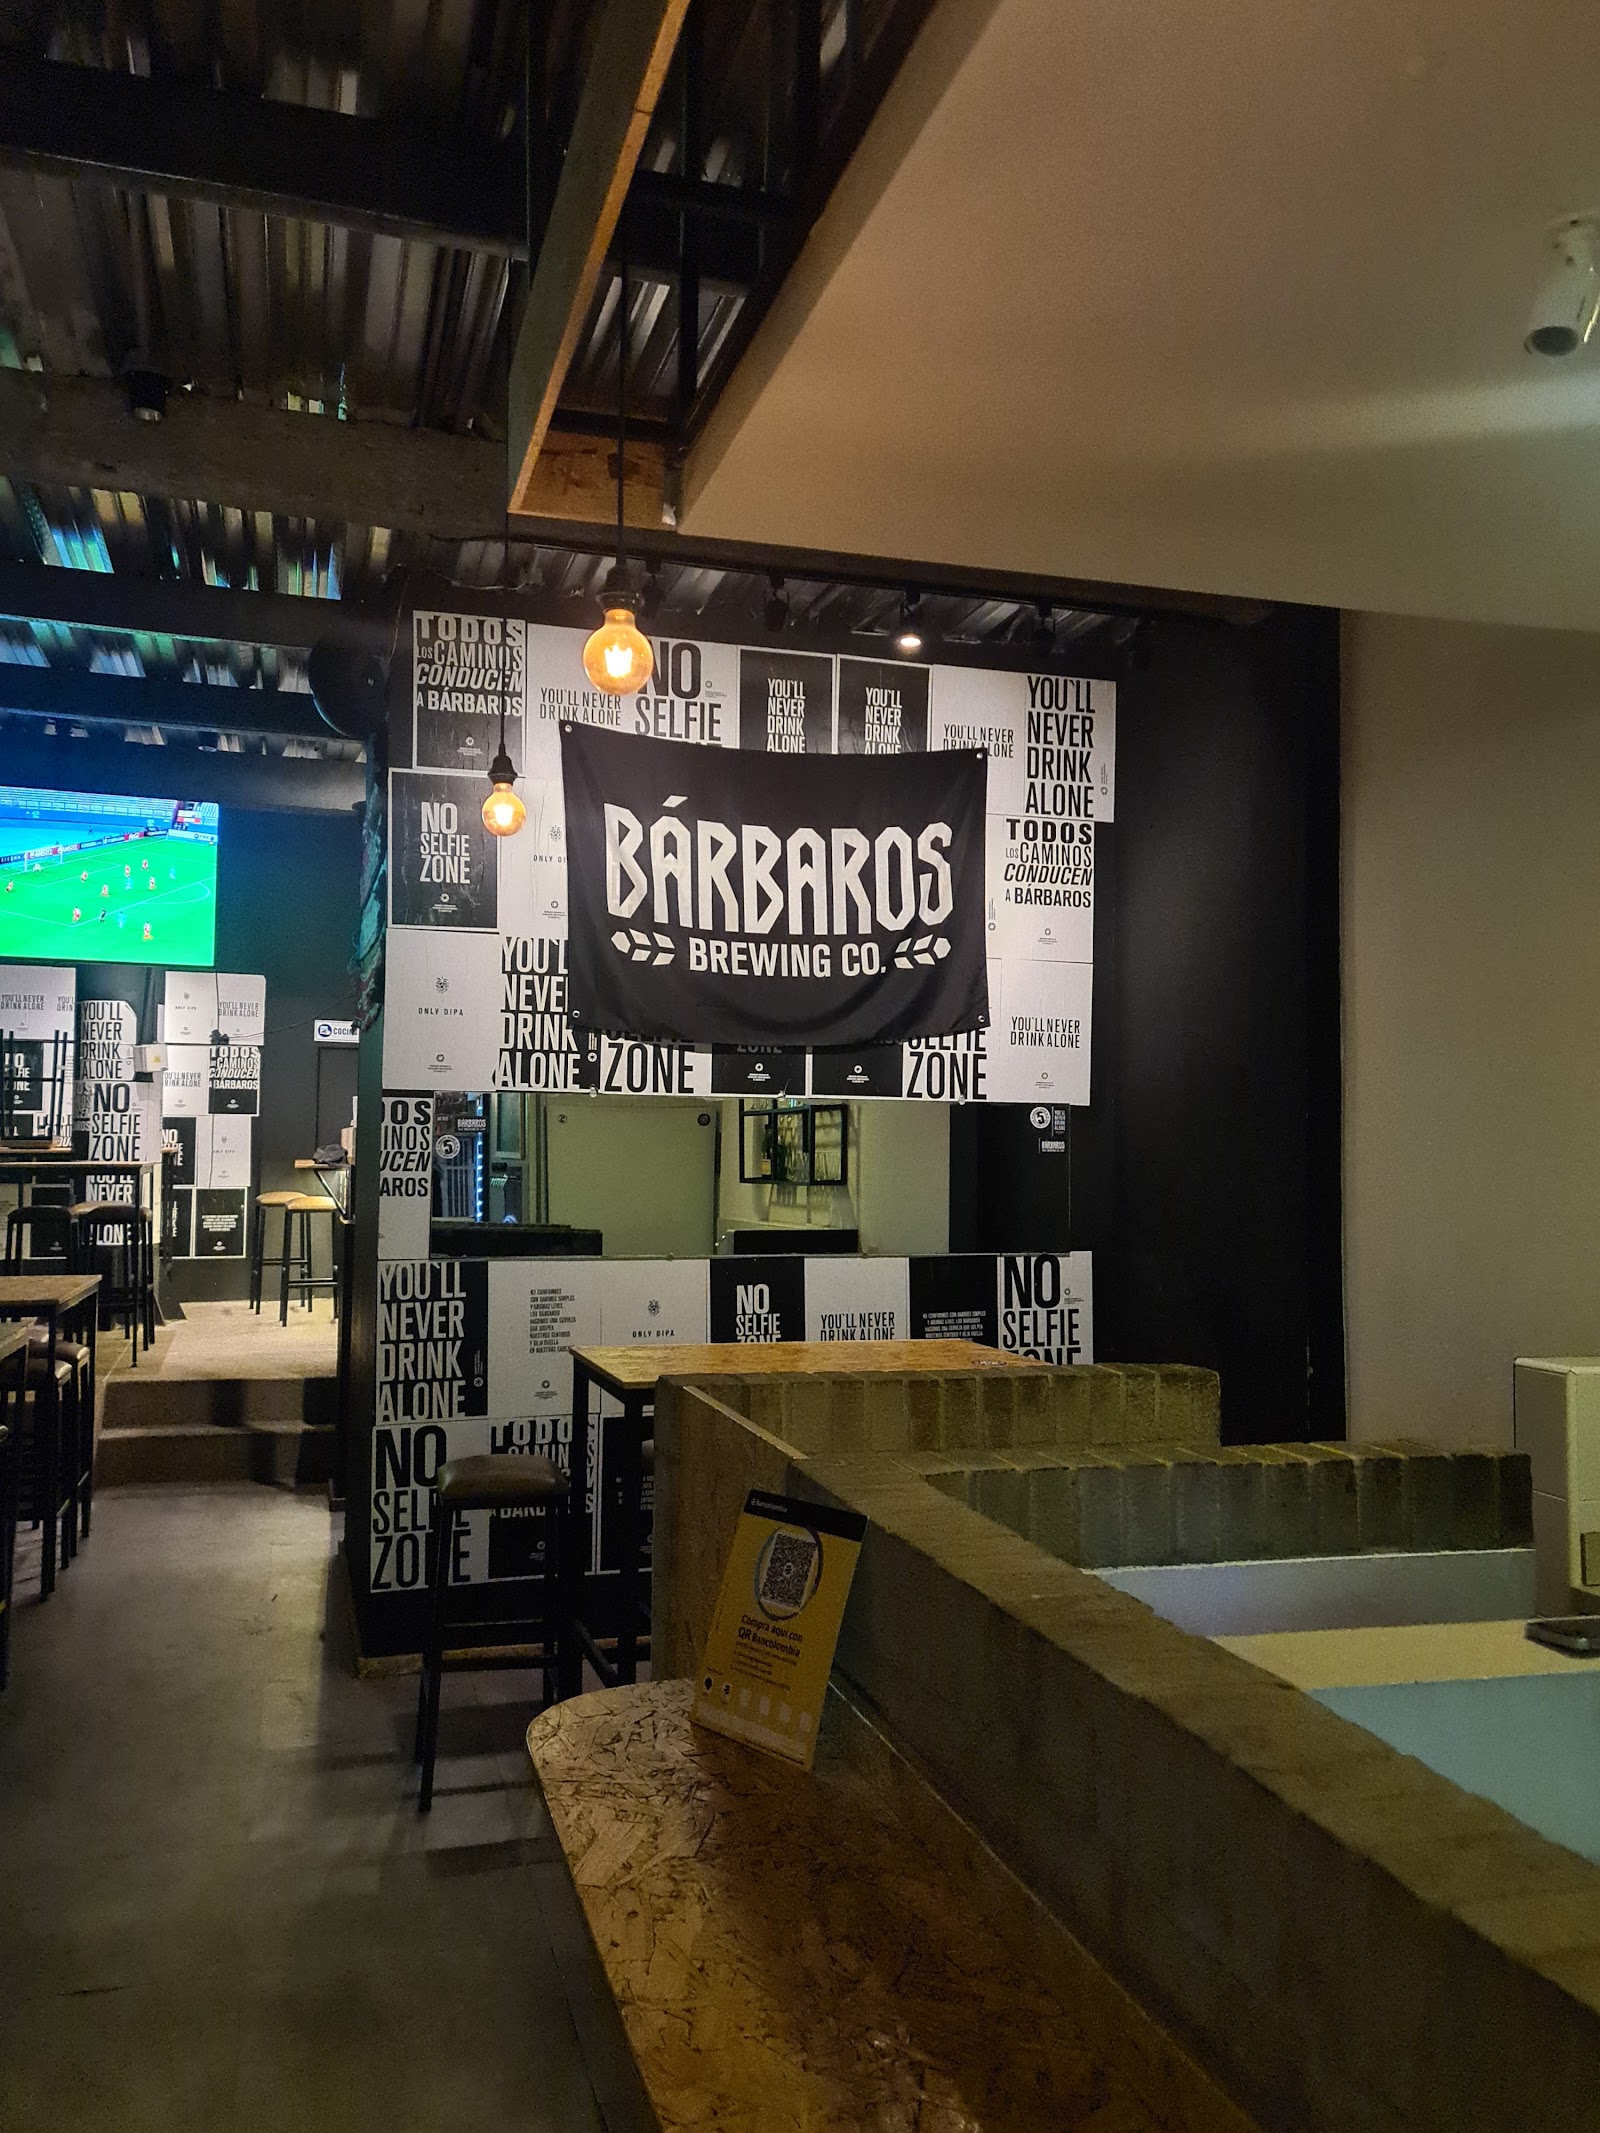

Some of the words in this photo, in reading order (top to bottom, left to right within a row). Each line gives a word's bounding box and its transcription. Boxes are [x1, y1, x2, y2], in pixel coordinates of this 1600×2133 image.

[417, 614, 522, 647] TODOS
[417, 646, 433, 659] LOS
[434, 640, 522, 672] CAMINOS
[417, 663, 522, 692] CONDUCEN
[417, 692, 424, 707] A
[428, 686, 522, 717] BÁRBAROS
[583, 691, 621, 710] NEVER
[768, 697, 805, 718] NEVER
[540, 703, 579, 722] DRINK
[582, 706, 621, 726] ALONE
[635, 696, 722, 742] SELFIE
[767, 715, 805, 736] DRINK
[866, 706, 902, 727] NEVER
[865, 724, 900, 744] DRINK
[980, 727, 1014, 744] NEVER
[1027, 712, 1095, 749] NEVER
[767, 734, 806, 754] ALONE
[1027, 748, 1093, 783] DRINK
[1025, 782, 1095, 818] ALONE
[421, 801, 457, 834] NO
[1006, 818, 1093, 844] TODOS
[420, 832, 470, 858] SELFIE
[1005, 847, 1019, 859] LOS
[1019, 842, 1092, 867] CAMINOS
[419, 854, 470, 885] ZONE
[533, 853, 553, 863] ONLY
[557, 854, 567, 863] DI
[604, 795, 953, 936] BÁRBAROS
[1004, 864, 1093, 887] CONDUCEN
[1005, 889, 1012, 902] A
[1015, 883, 1092, 908] BÁRBAROS
[689, 937, 831, 978] BREWING
[841, 942, 887, 976] CO.
[23, 994, 44, 1003] NEVER
[502, 974, 568, 1012] NEVE
[1, 1001, 22, 1010] DRINK
[23, 1002, 44, 1011] ALONE
[219, 1009, 238, 1017] DRINK
[239, 1009, 259, 1017] ALONE
[240, 1002, 259, 1010] NEVER
[418, 1007, 440, 1016] ONLY
[444, 1008, 464, 1016] DIPA
[81, 1021, 122, 1041] NEVER
[501, 1013, 578, 1051] DRINK
[1047, 1018, 1081, 1035] NEVER
[82, 1041, 120, 1060] DRINK
[1010, 1031, 1044, 1048] DRINK
[1047, 1033, 1081, 1049] ALONE
[209, 1046, 261, 1058] TODOS
[217, 1057, 260, 1069] CAMINOS
[82, 1060, 123, 1079] ALONE
[181, 1072, 201, 1080] NEVER
[209, 1067, 259, 1079] CONDUCEN
[499, 1051, 580, 1090] ALONE
[604, 1042, 695, 1093] ZONE
[907, 1051, 987, 1100] ZONE
[94, 1083, 130, 1113] NO
[92, 1113, 141, 1135] SELFIE
[161, 1128, 178, 1143] NO
[90, 1135, 141, 1162] ZONE
[87, 1184, 133, 1203] NEVER
[1004, 1255, 1060, 1309] NO
[736, 1284, 770, 1315] NO
[379, 1301, 465, 1342] NEVER
[736, 1313, 780, 1336] SELFIE
[859, 1311, 895, 1328] NEVER
[1003, 1308, 1080, 1349] SELFIE
[632, 1330, 652, 1338] ONLY
[820, 1328, 856, 1341] DRINK
[379, 1341, 463, 1382] DRINK
[379, 1380, 466, 1423] ALONE
[375, 1425, 447, 1490] NO
[738, 1626, 752, 1641] QR
